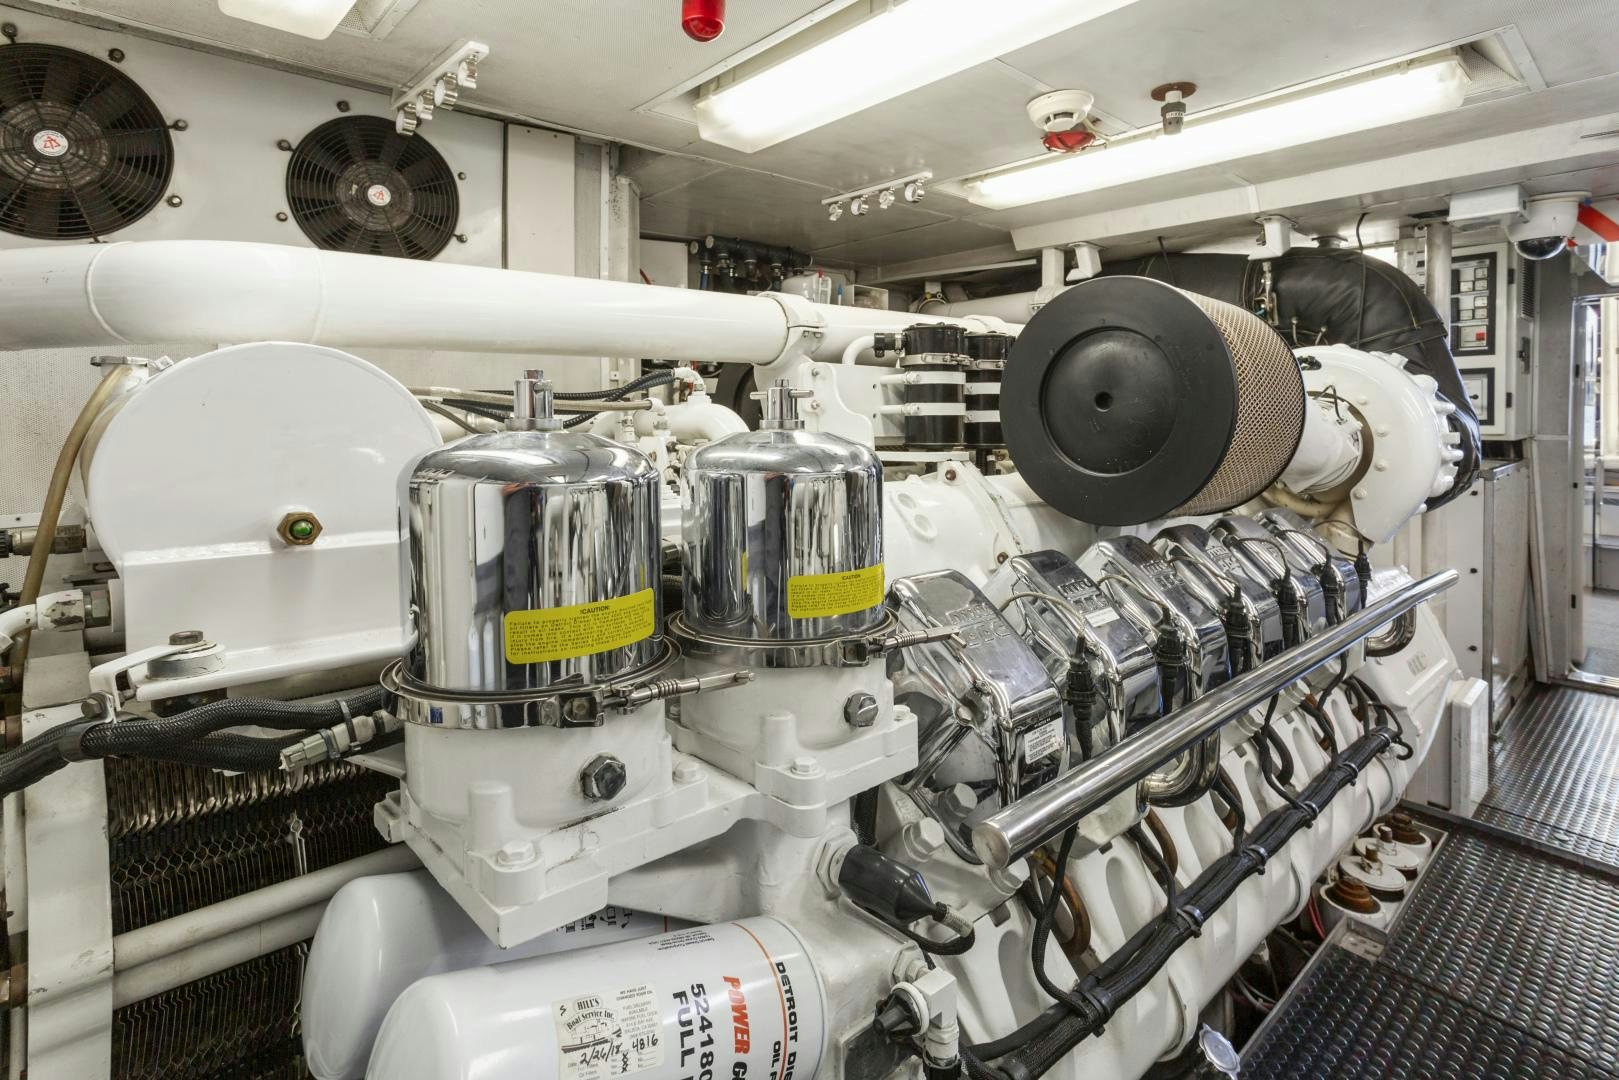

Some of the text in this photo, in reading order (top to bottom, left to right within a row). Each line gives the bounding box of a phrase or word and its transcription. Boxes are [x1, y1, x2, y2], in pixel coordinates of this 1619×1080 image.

[577, 998, 599, 1010] HILL'S
[723, 976, 750, 1054] POWER
[776, 962, 798, 1042] DETROIT
[566, 1010, 615, 1030] Boat Service Inc.
[672, 990, 694, 1068] FULL
[580, 1042, 622, 1066] 2/26/18
[632, 1034, 658, 1052] 4816
[771, 1040, 781, 1068] OIL
